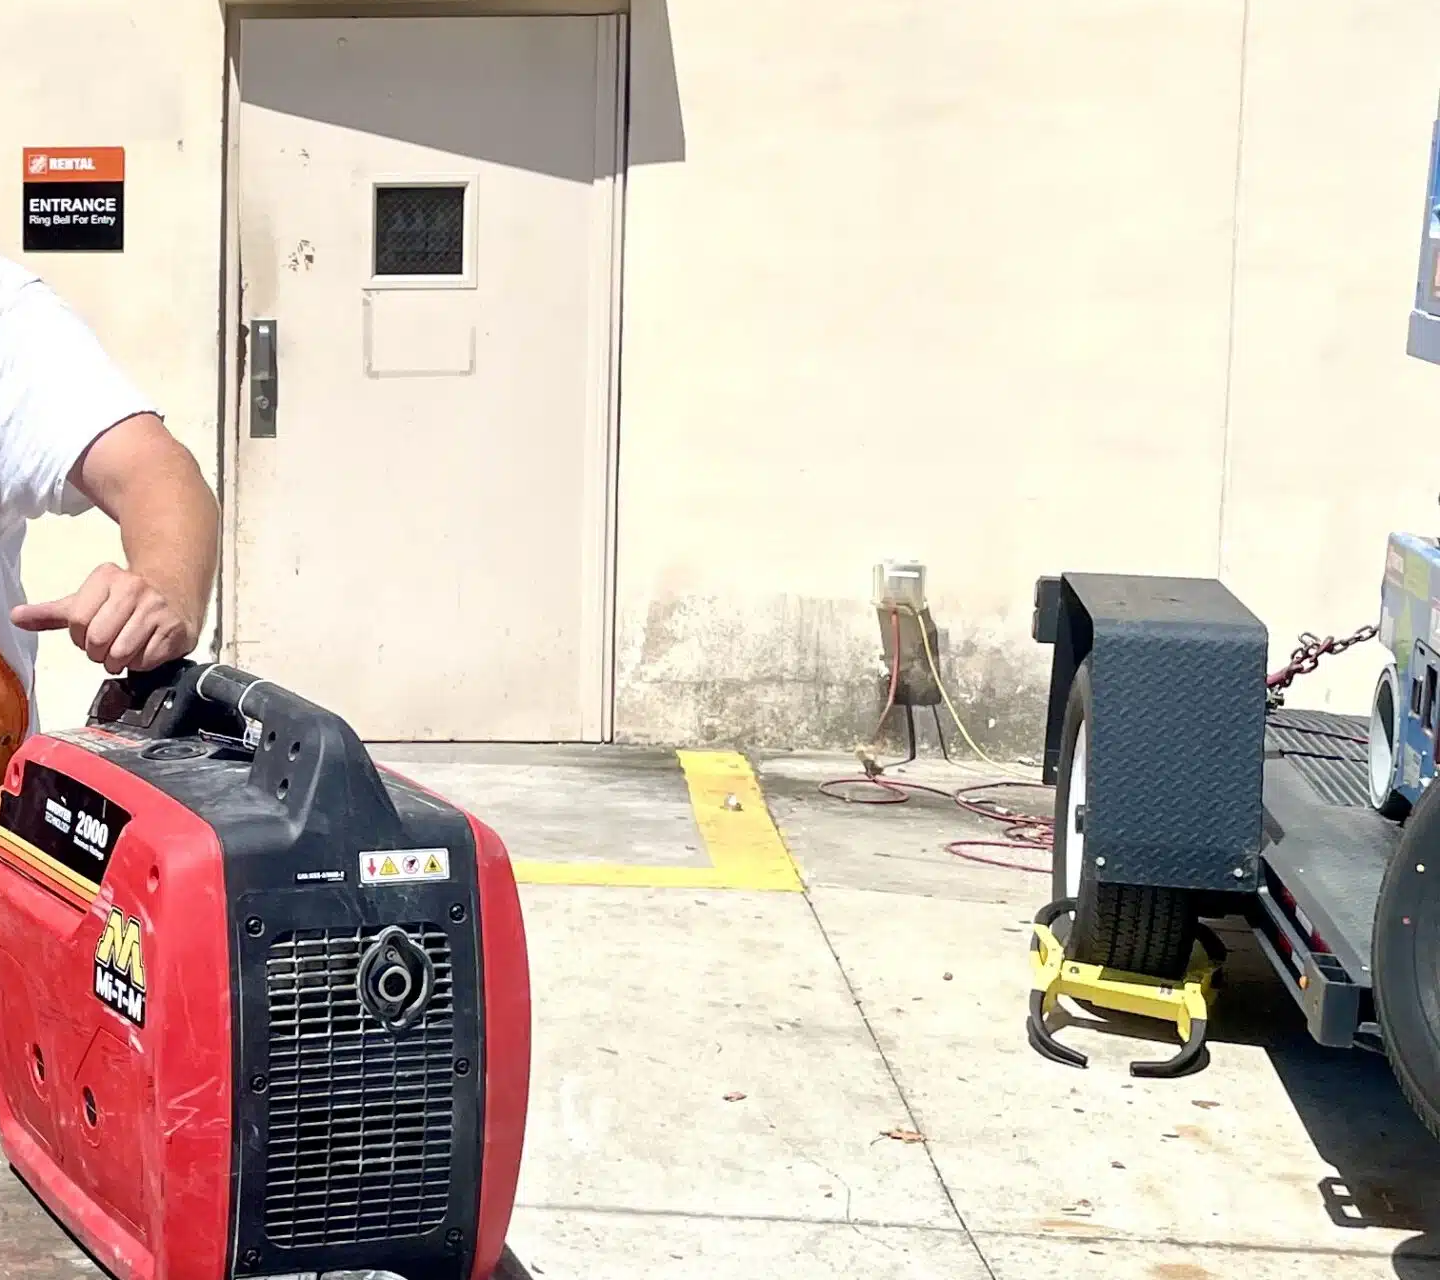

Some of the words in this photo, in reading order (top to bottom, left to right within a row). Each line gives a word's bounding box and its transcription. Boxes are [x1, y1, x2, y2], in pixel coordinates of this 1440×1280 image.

[49, 157, 96, 170] RENTAL
[29, 198, 117, 212] ENTRANCE
[29, 214, 51, 227] Ring
[53, 214, 70, 224] Bell
[72, 214, 88, 224] For
[91, 214, 116, 226] Entry
[75, 810, 109, 849] 2000
[95, 965, 143, 1022] Mi-T-M
